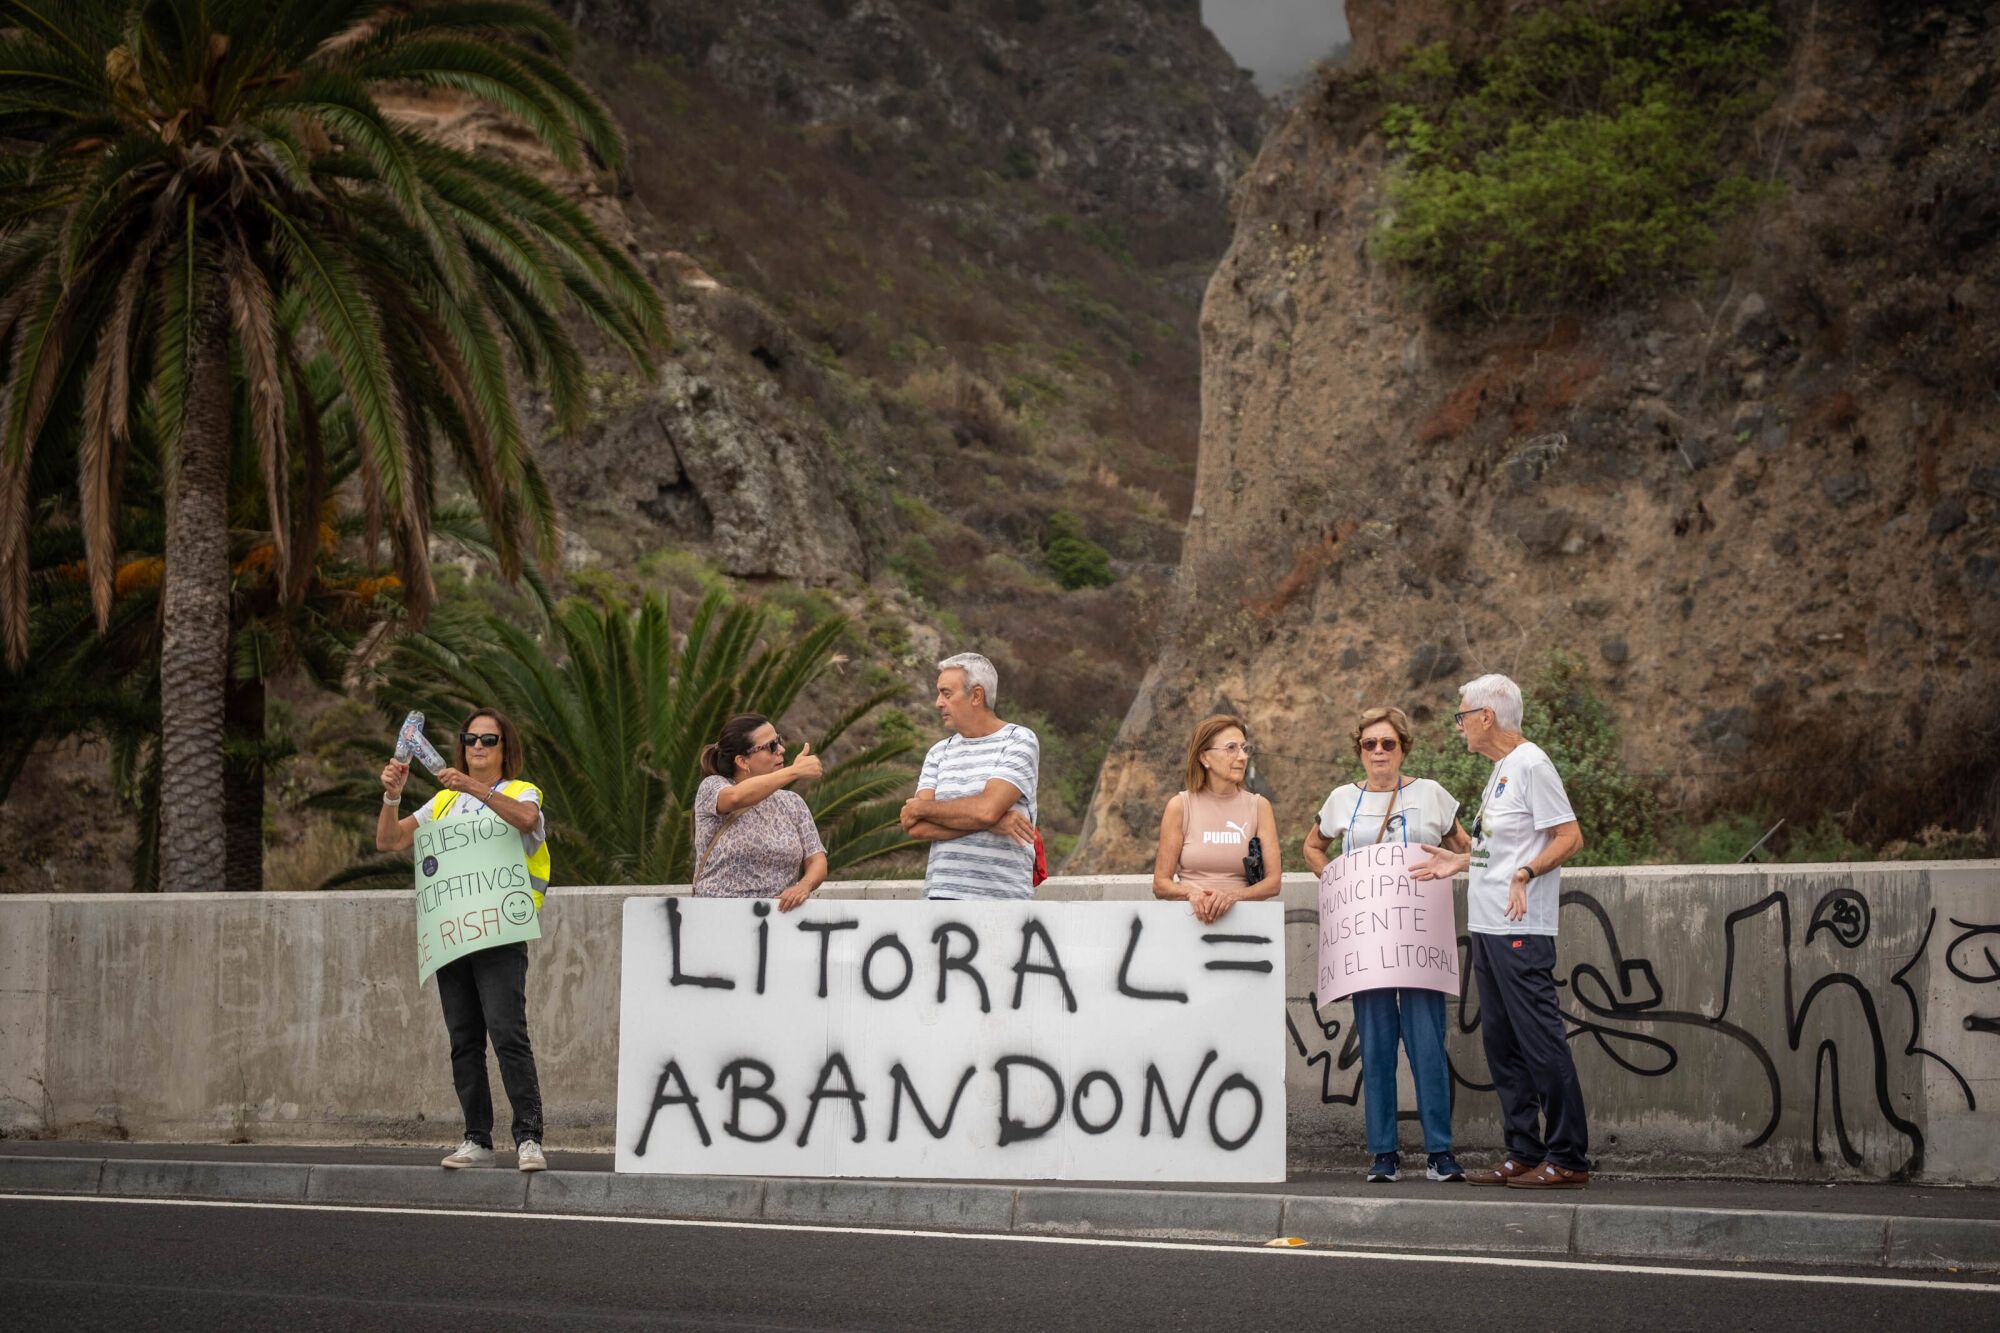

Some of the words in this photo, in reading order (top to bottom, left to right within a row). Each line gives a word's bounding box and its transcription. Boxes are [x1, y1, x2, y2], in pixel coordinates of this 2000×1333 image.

[1203, 831, 1241, 844] PUMA
[416, 863, 526, 921] TICIPATIVOS
[439, 908, 501, 950] RISA
[1322, 906, 1428, 951] AUSENTE
[1320, 961, 1335, 990] EN
[1344, 951, 1368, 976] EL
[634, 1050, 1263, 1155] ABANDONO
